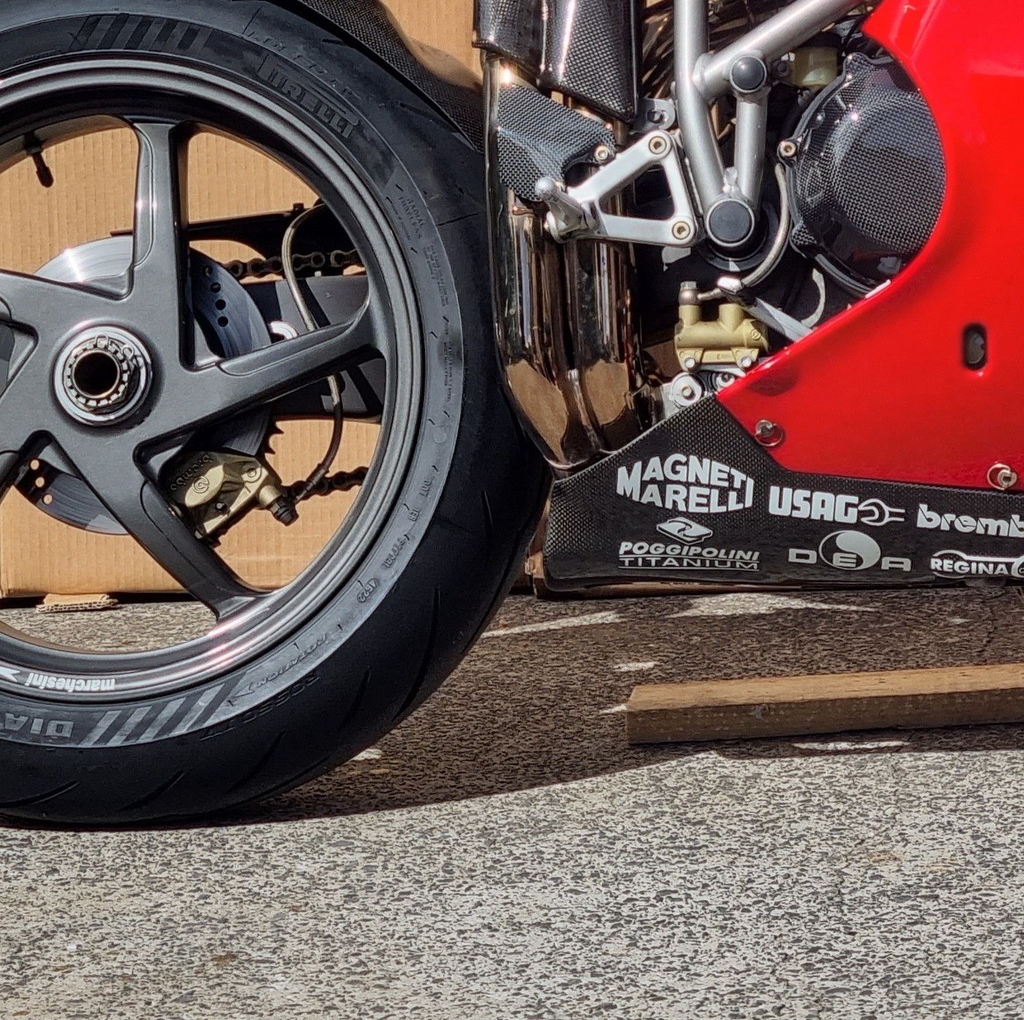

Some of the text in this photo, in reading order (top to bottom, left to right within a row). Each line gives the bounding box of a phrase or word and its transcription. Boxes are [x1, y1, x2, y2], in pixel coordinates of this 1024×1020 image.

[616, 453, 755, 501] MAGNETI
[616, 477, 755, 514] MARELLI
[768, 485, 859, 525] USAG
[618, 541, 760, 560] POGGIPOLINI
[619, 557, 758, 569] TITANIUM
[930, 557, 1008, 576] REGINA
[24, 673, 116, 693] marchesini
[0, 712, 74, 738] DIA
